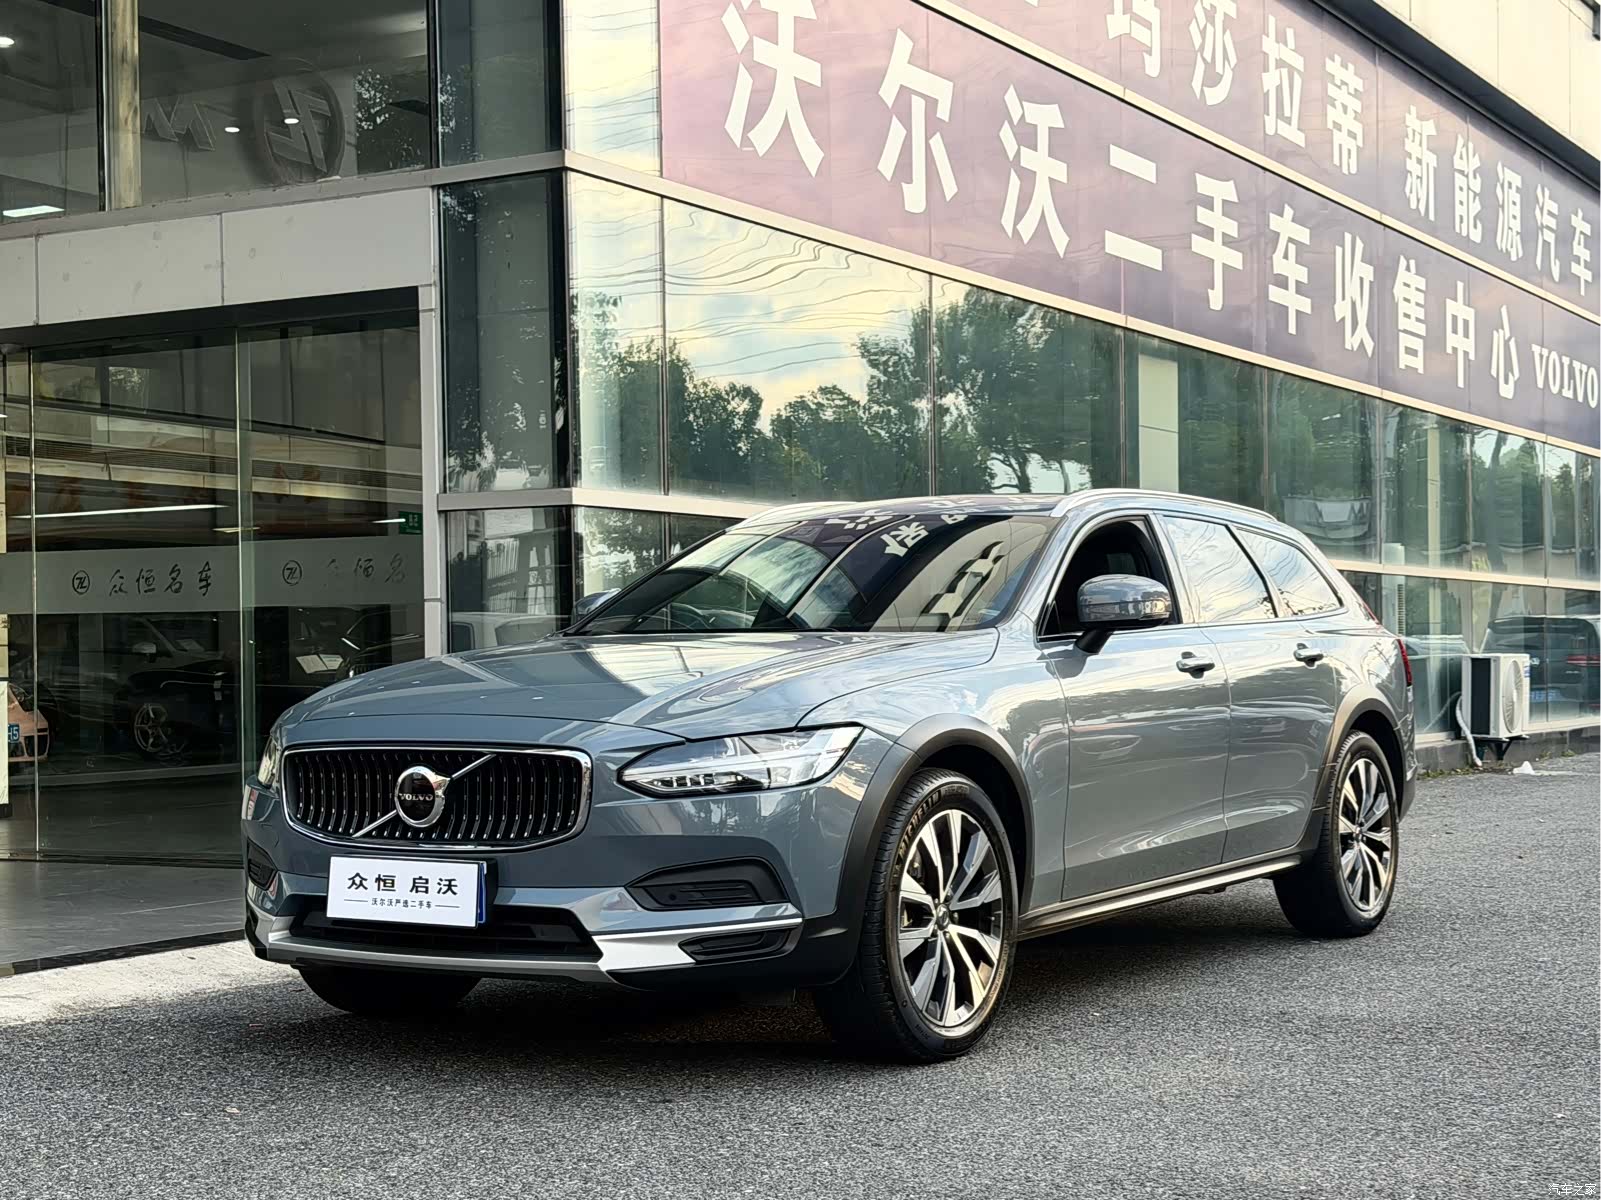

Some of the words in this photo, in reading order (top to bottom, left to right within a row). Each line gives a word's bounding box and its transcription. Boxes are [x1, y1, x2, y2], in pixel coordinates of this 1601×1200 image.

[720, 0, 1520, 400] 沃尔沃二手车收售中心
[1531, 343, 1599, 408] VOLVO
[1404, 105, 1593, 296] 新能源汽车
[109, 560, 212, 597] 众恒名车
[398, 793, 434, 801] VOLVO
[347, 872, 397, 892] 众恒
[409, 876, 458, 895] 启沃
